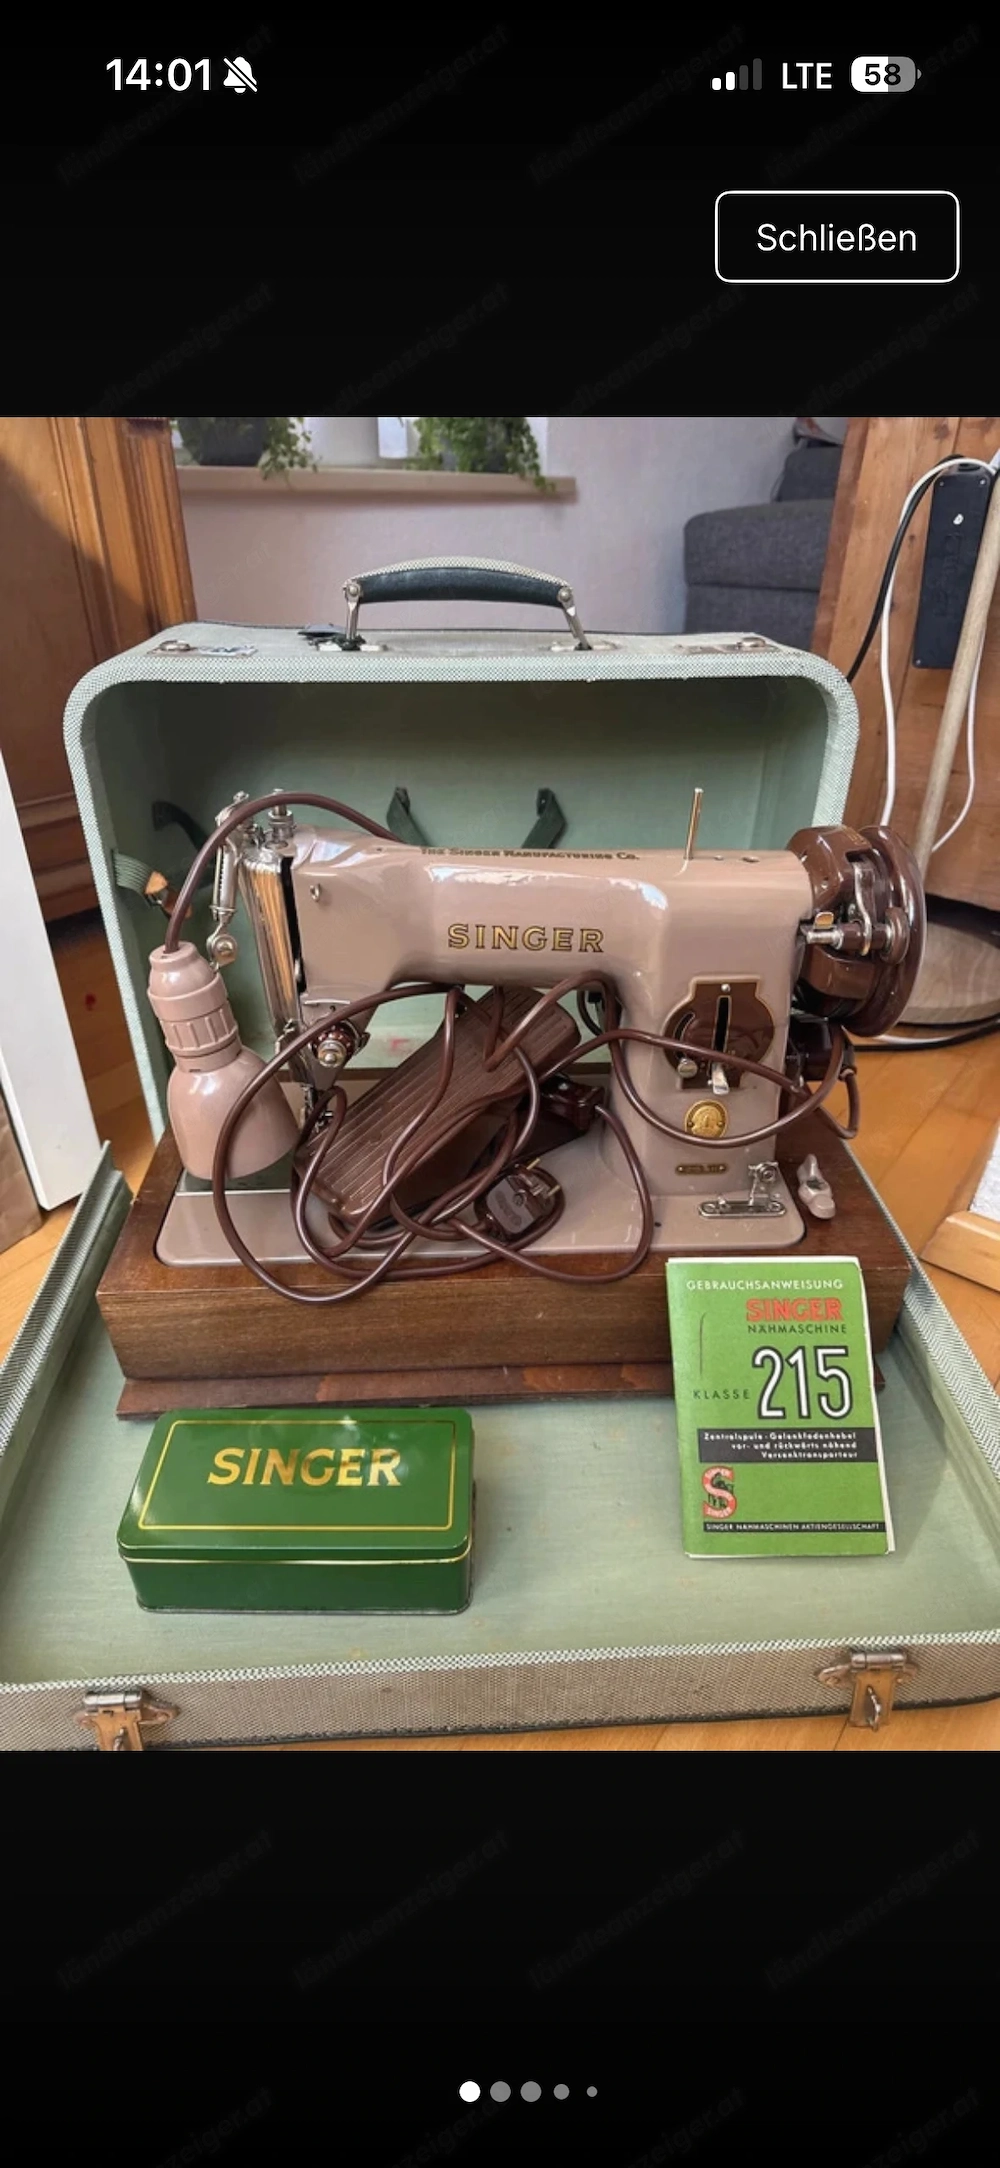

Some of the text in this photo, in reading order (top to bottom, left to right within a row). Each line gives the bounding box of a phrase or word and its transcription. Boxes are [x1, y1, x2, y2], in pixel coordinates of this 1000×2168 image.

[106, 58, 210, 92] 14:01
[782, 62, 833, 90] LTE
[864, 63, 902, 86] 58
[757, 223, 917, 252] Schließen
[447, 922, 604, 953] SINGER
[686, 1278, 844, 1291] GEBRAUCHSANWEISUNG
[745, 1297, 843, 1322] SINGER
[747, 1323, 847, 1335] NÄHMASCHINE
[692, 1345, 854, 1420] KLASSE 215
[753, 1441, 771, 1450] und
[774, 1441, 819, 1450] rückwärts
[207, 1447, 402, 1487] SINGER
[705, 1522, 733, 1531] SINGER
